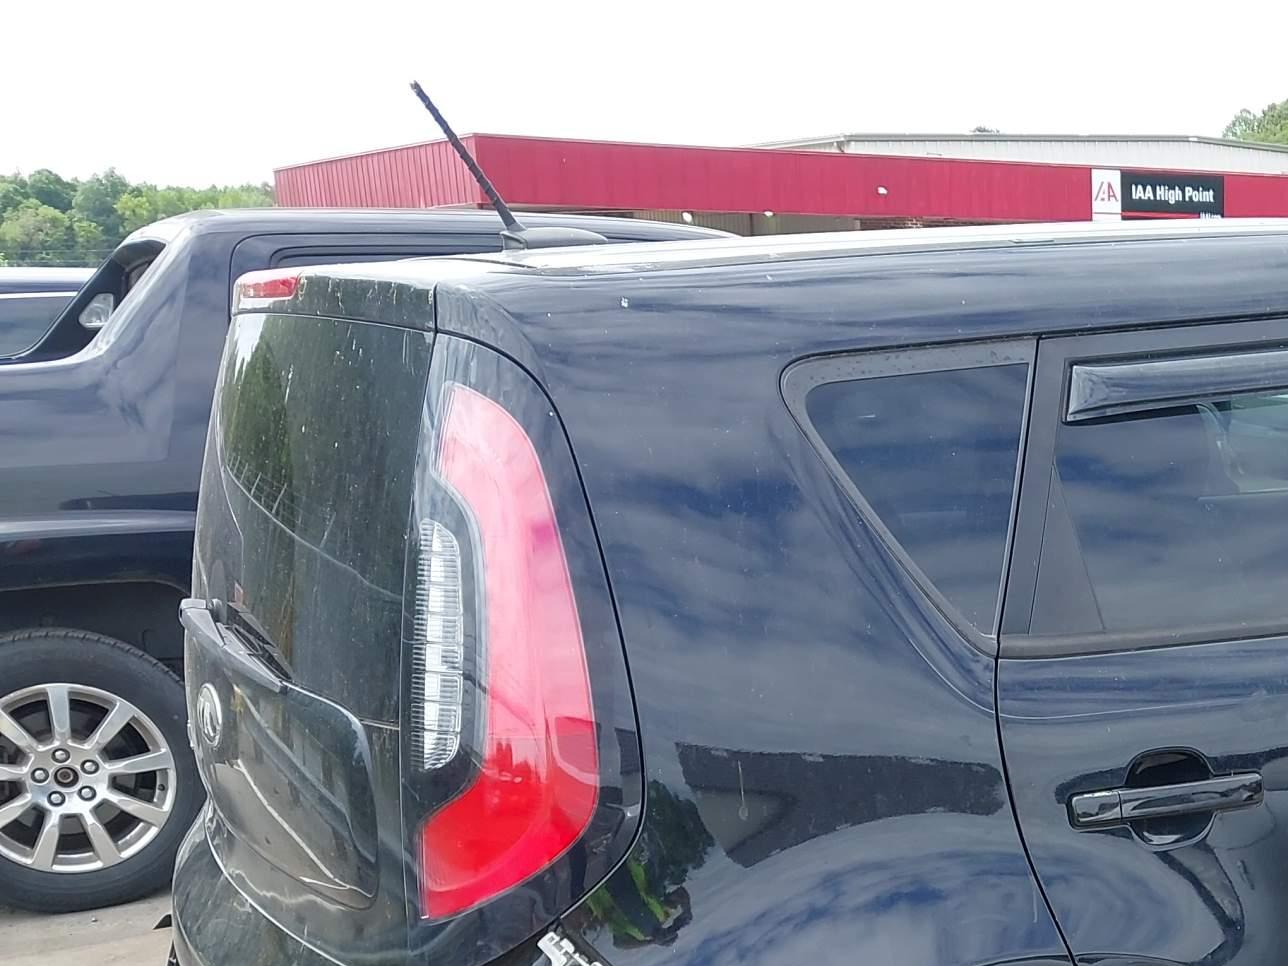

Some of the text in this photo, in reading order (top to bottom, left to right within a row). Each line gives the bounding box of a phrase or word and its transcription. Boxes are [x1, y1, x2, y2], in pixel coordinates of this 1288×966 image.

[1131, 183, 1215, 204] IAA High Point
